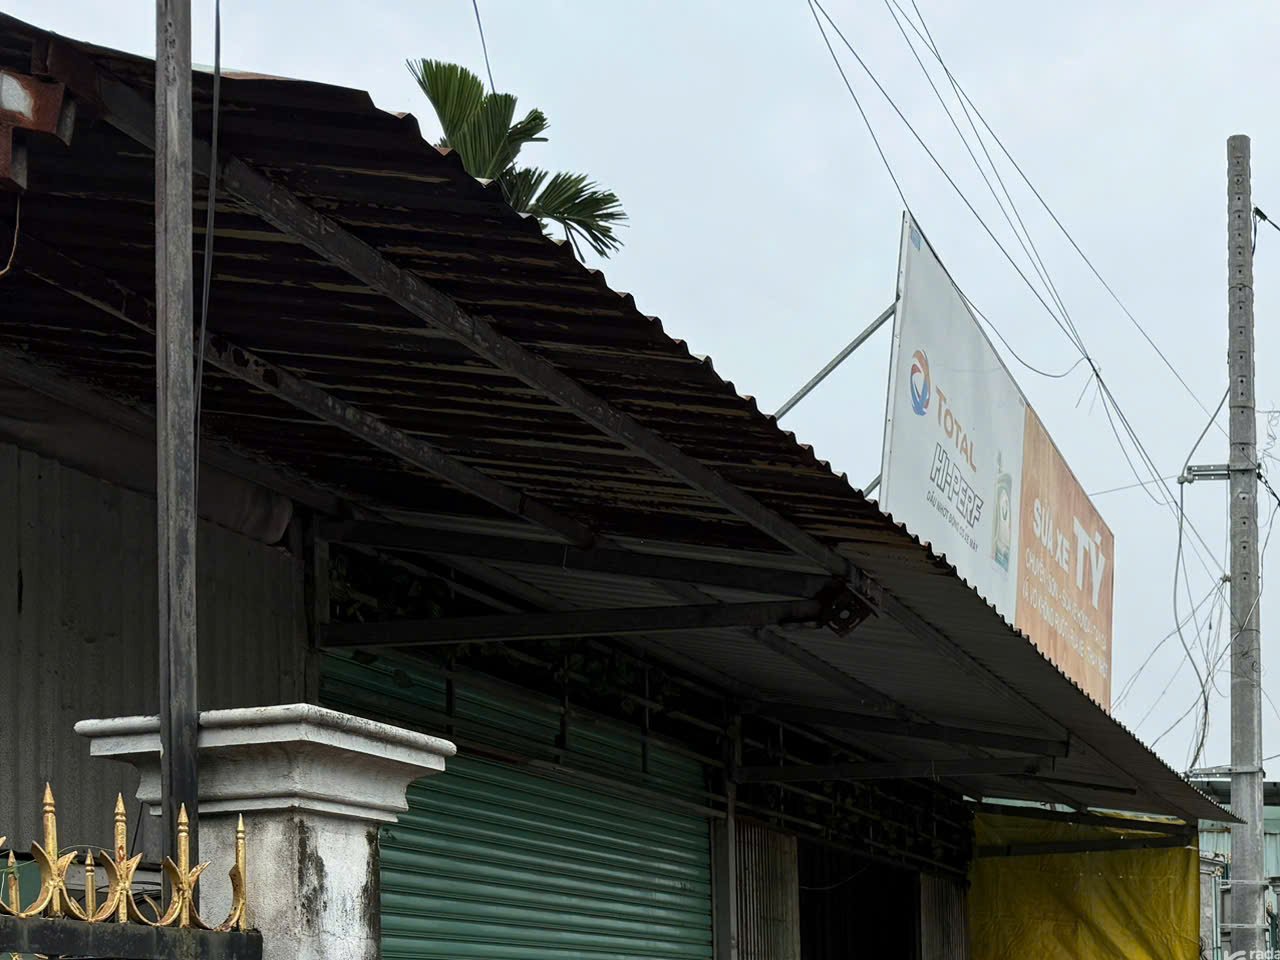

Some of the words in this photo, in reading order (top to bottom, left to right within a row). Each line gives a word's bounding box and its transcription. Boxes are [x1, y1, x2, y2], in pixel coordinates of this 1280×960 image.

[936, 385, 976, 472] TOTAL
[929, 442, 984, 528] HI-PERF
[1056, 528, 1070, 575] XE
